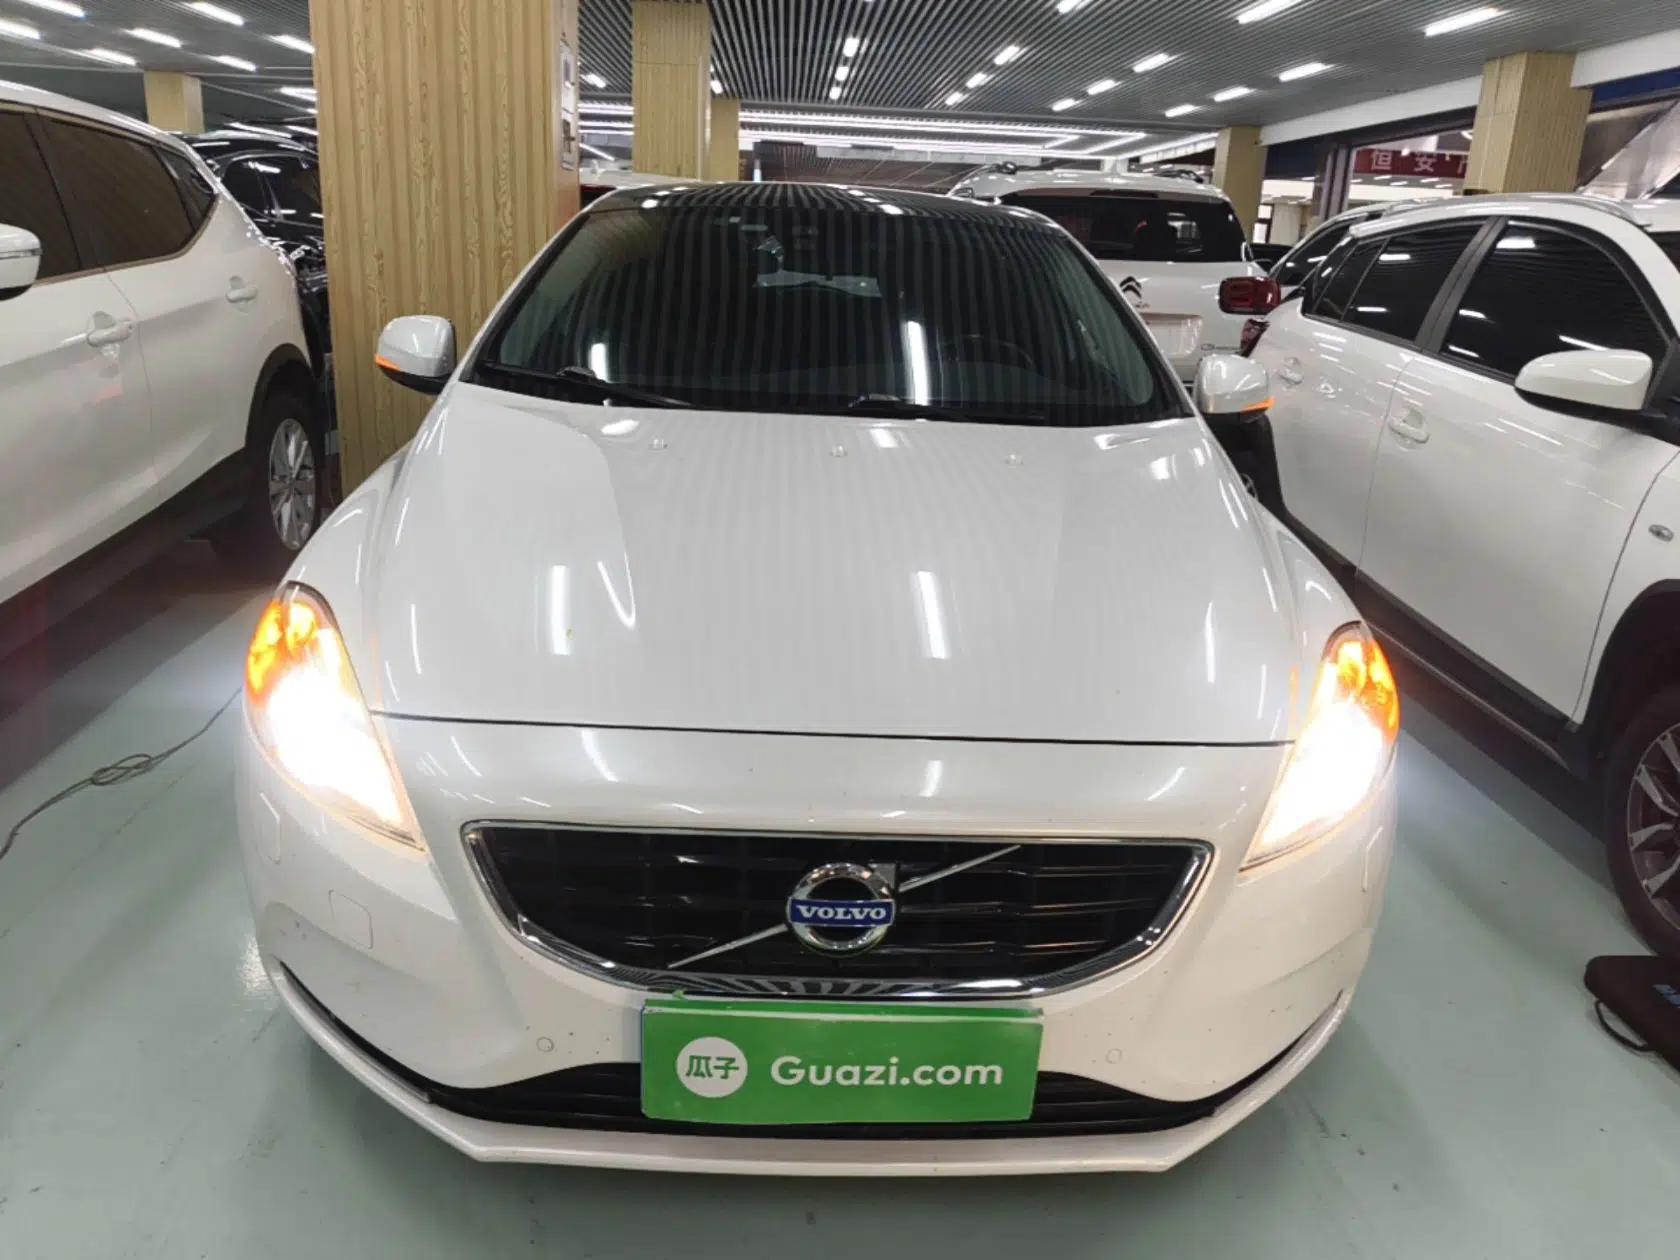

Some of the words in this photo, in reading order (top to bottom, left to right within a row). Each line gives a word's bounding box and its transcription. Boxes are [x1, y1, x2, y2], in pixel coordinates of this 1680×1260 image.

[796, 905, 887, 919] VOLVO
[685, 1055, 740, 1079] 瓜子
[770, 1056, 1003, 1087] Guazi.com
